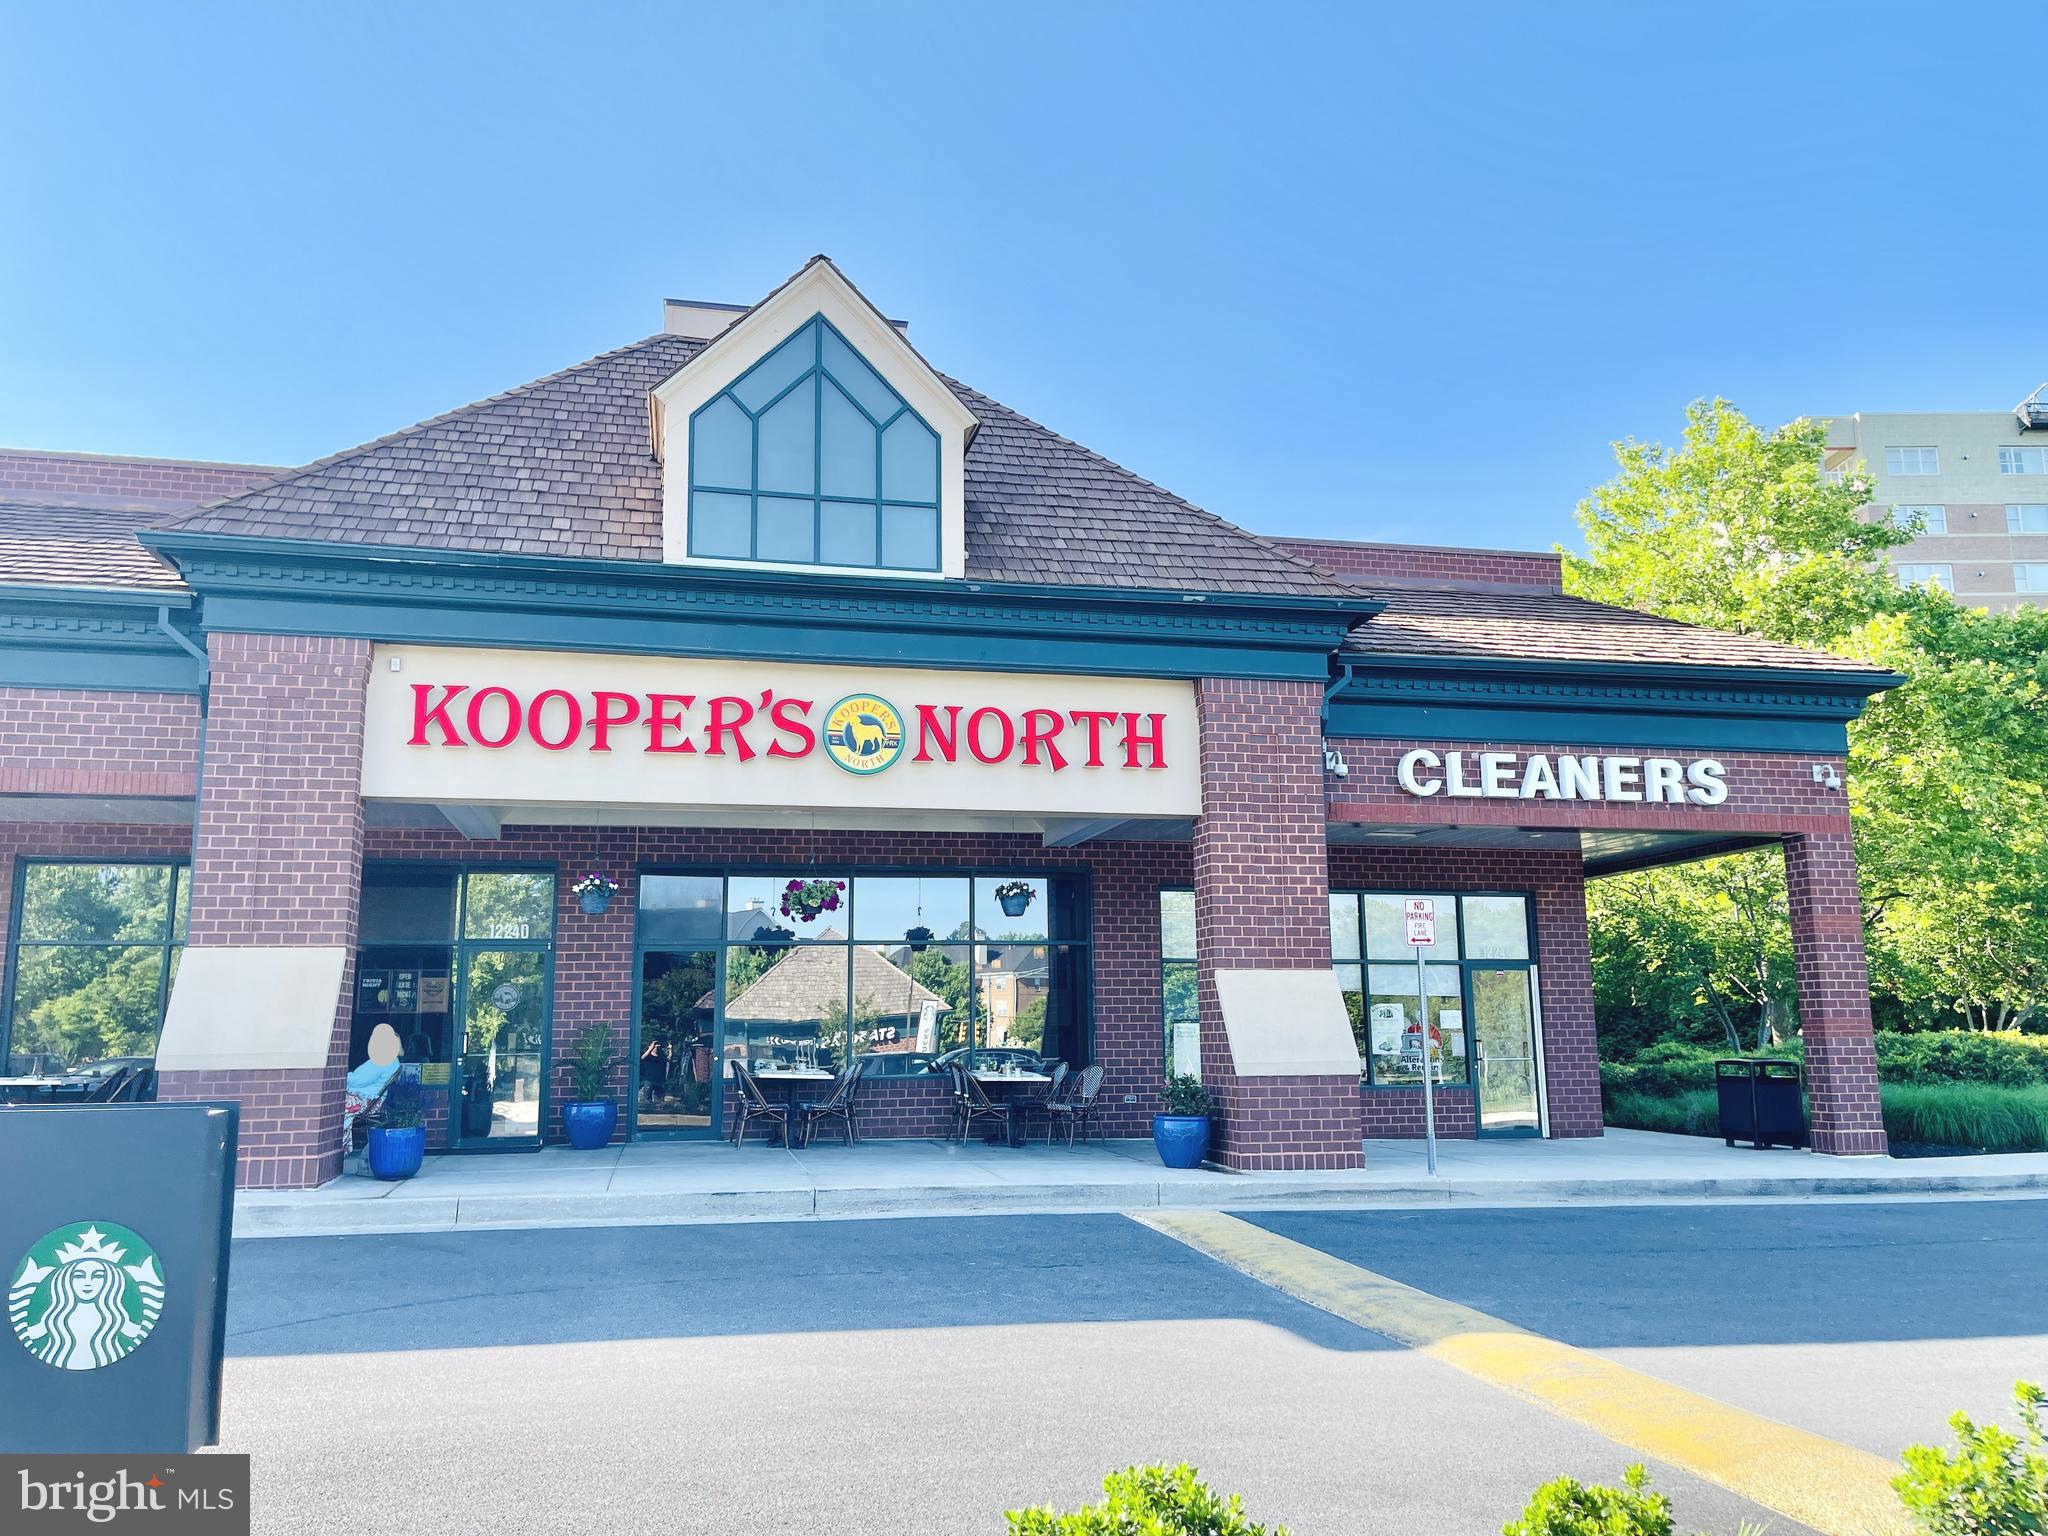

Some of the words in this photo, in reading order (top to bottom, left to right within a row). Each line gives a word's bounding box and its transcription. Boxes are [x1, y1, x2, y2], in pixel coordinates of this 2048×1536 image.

[407, 685, 815, 762] KOOPER'S
[911, 704, 1168, 773] NORTH
[845, 754, 885, 768] NORTH
[1397, 749, 1729, 805] CLEANERS
[1413, 901, 1425, 911] NO
[1406, 912, 1433, 921] PARKING
[490, 924, 530, 939] 12240
